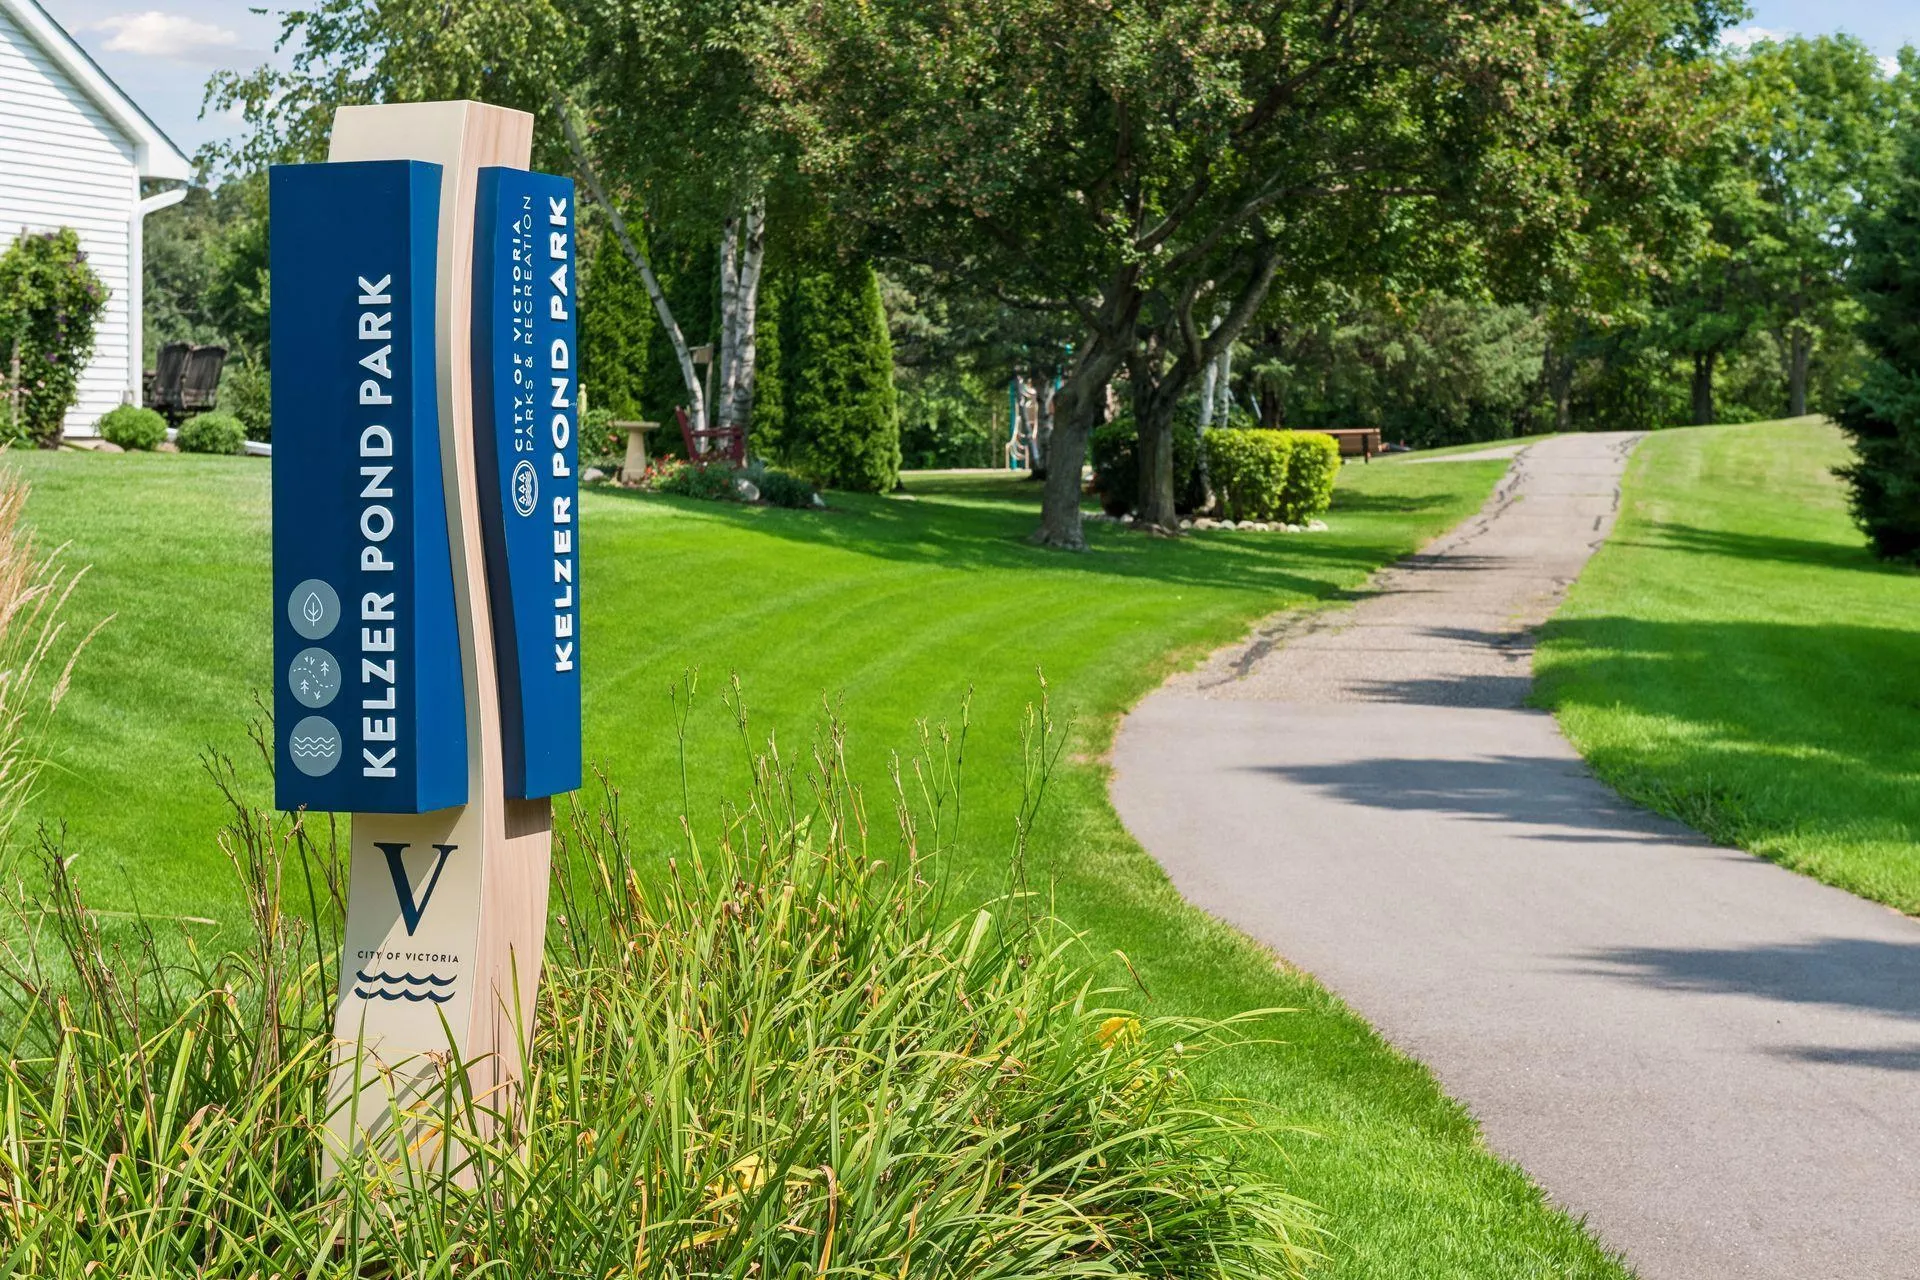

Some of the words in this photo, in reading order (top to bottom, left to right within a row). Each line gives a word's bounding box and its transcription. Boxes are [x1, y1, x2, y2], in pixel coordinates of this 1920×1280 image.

[512, 220, 522, 341] VICTORIA
[523, 196, 533, 344] RECREATION
[549, 196, 568, 321] PARK
[358, 273, 392, 405] PARK
[513, 353, 522, 385] OF
[524, 356, 533, 368] &
[514, 396, 523, 452] CITY
[525, 379, 534, 451] PARKS
[551, 338, 571, 477] POND
[359, 424, 394, 571] POND
[553, 496, 573, 673] KELZER
[361, 592, 396, 778] KELZER
[373, 842, 458, 936] V
[357, 950, 382, 959] CITY
[386, 952, 401, 960] OF
[405, 953, 459, 963] VICTORIA
